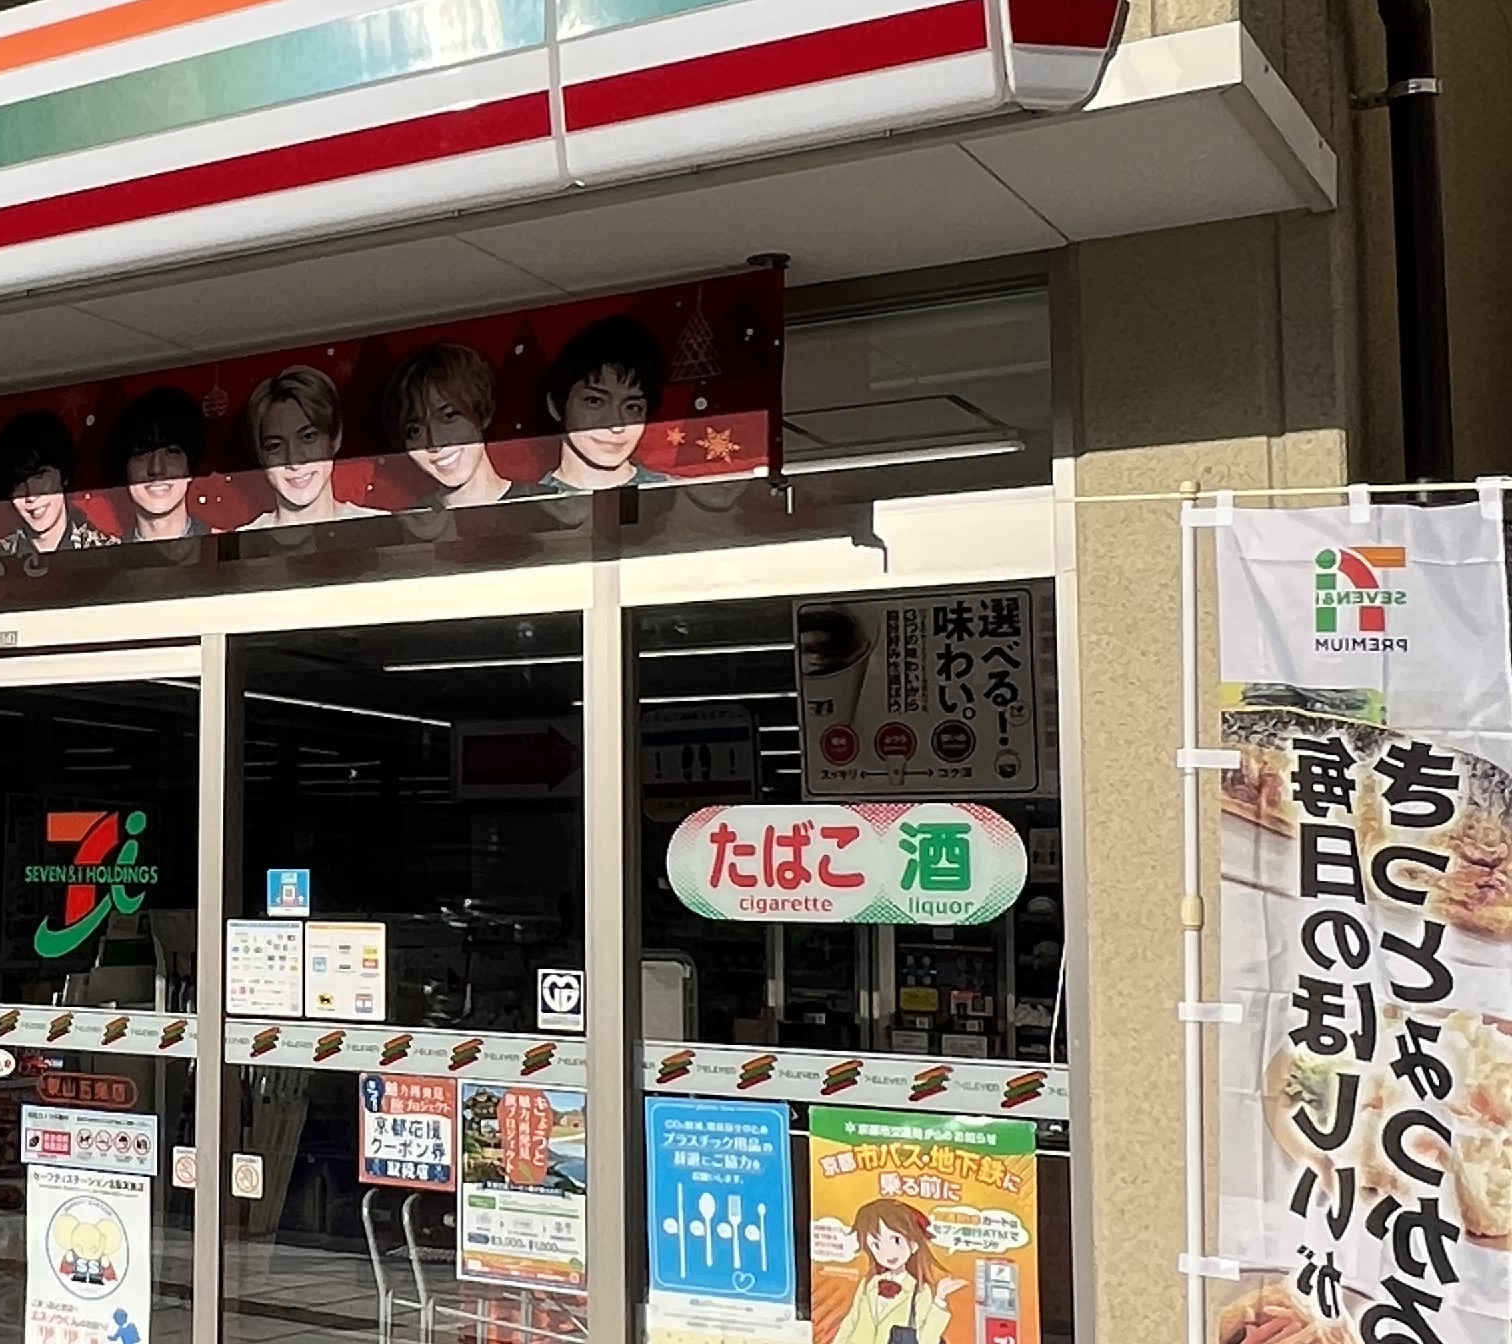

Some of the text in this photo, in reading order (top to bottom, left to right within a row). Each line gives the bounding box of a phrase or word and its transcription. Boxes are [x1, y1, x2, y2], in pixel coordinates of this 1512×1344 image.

[933, 601, 976, 720] 味わい。
[978, 597, 1021, 746] 選べる!
[708, 819, 973, 892] たばこ 酒
[86, 864, 158, 884] HOLDINGS
[739, 895, 975, 918] cigarette liquor
[370, 1136, 446, 1162] クーポン券
[879, 1171, 962, 1202] 乗る前に
